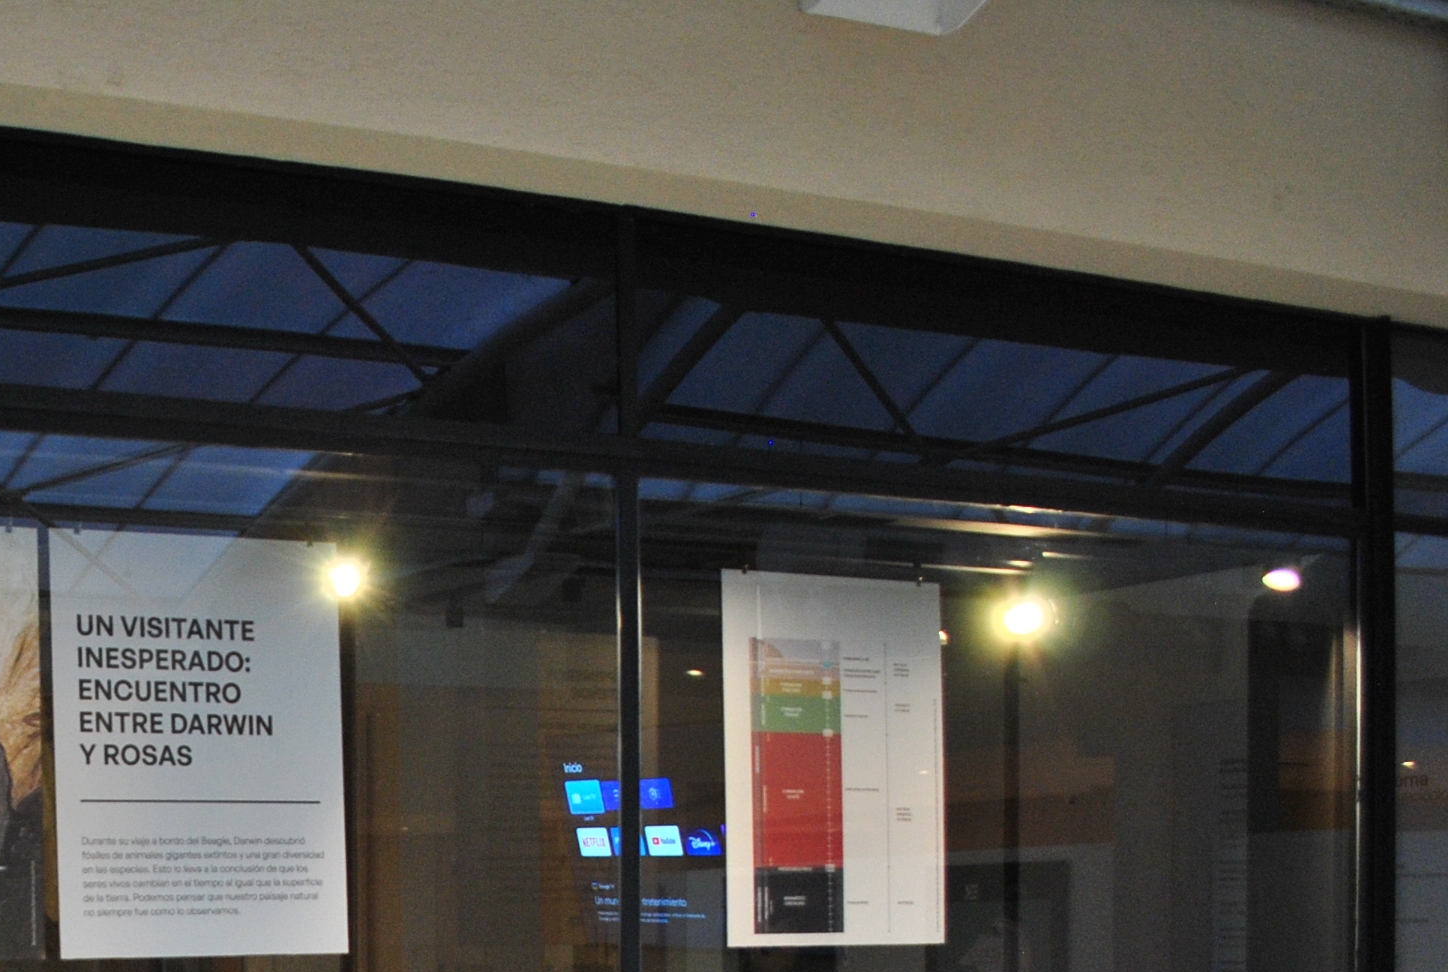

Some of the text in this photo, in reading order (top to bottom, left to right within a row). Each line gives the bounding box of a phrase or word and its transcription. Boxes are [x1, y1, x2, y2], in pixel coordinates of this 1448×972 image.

[77, 615, 255, 641] UN VISITANTE
[77, 646, 251, 672] INESPERADO:
[78, 680, 241, 704] ENCUENTRO
[79, 712, 273, 736] ENTRE DARWIN
[80, 745, 193, 766] Y ROSAS
[563, 762, 583, 773] Inicio
[81, 836, 117, 845] Durante
[159, 836, 184, 845] bordo
[201, 836, 232, 847] Beagle,
[234, 836, 263, 845] Darwin
[264, 836, 305, 845] descubrió
[582, 837, 606, 847] NETFLIX
[125, 851, 164, 860] animales
[165, 850, 202, 861] gigantes
[203, 850, 238, 859] extintos
[262, 852, 281, 861] gran
[282, 850, 325, 859] diversidad
[152, 865, 172, 873] Esto
[220, 865, 264, 873] conclusión
[132, 879, 170, 888] cambian
[193, 879, 224, 889] tiempo
[234, 878, 254, 888] igual
[282, 878, 323, 888] superficie
[133, 893, 174, 902] Podemos
[175, 894, 205, 903] pensar
[225, 892, 258, 901] nuestro
[259, 892, 288, 902] paisaje
[290, 892, 318, 900] natural
[97, 908, 133, 918] siempre
